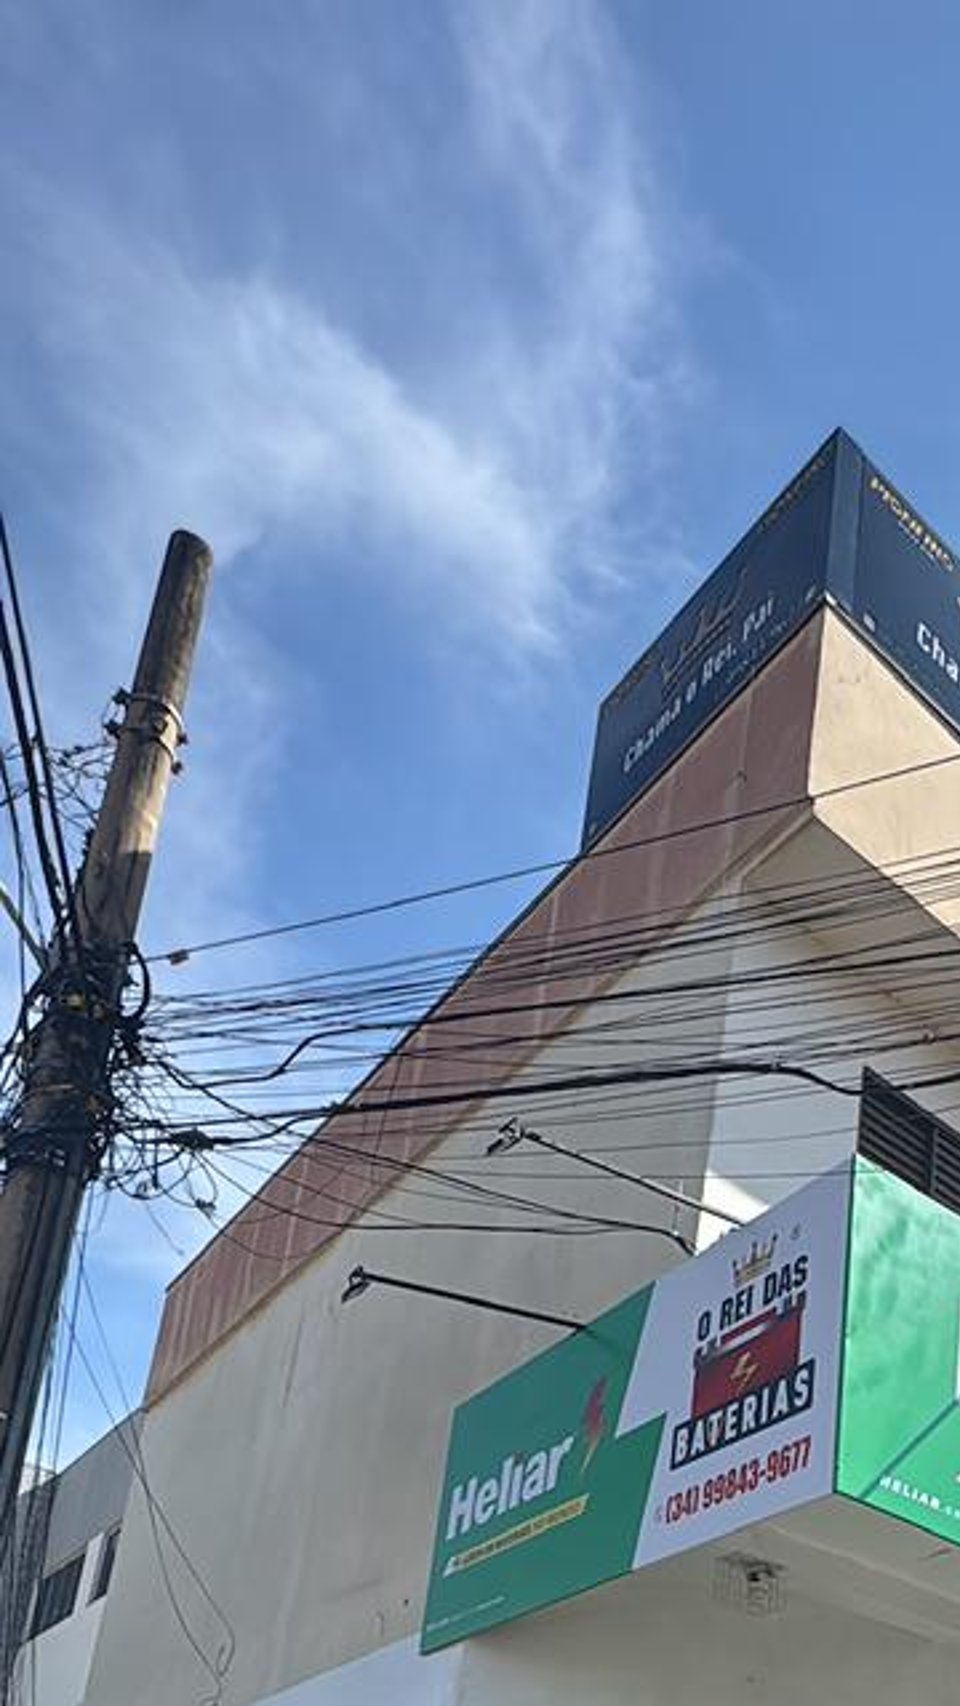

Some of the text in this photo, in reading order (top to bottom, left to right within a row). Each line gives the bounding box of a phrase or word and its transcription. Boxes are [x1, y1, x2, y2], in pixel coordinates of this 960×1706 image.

[698, 1254, 809, 1341] O REI DAS
[674, 1368, 811, 1467] BATERIAS
[445, 1434, 575, 1541] Heliar
[666, 1435, 812, 1524] (34) 99843-9677
